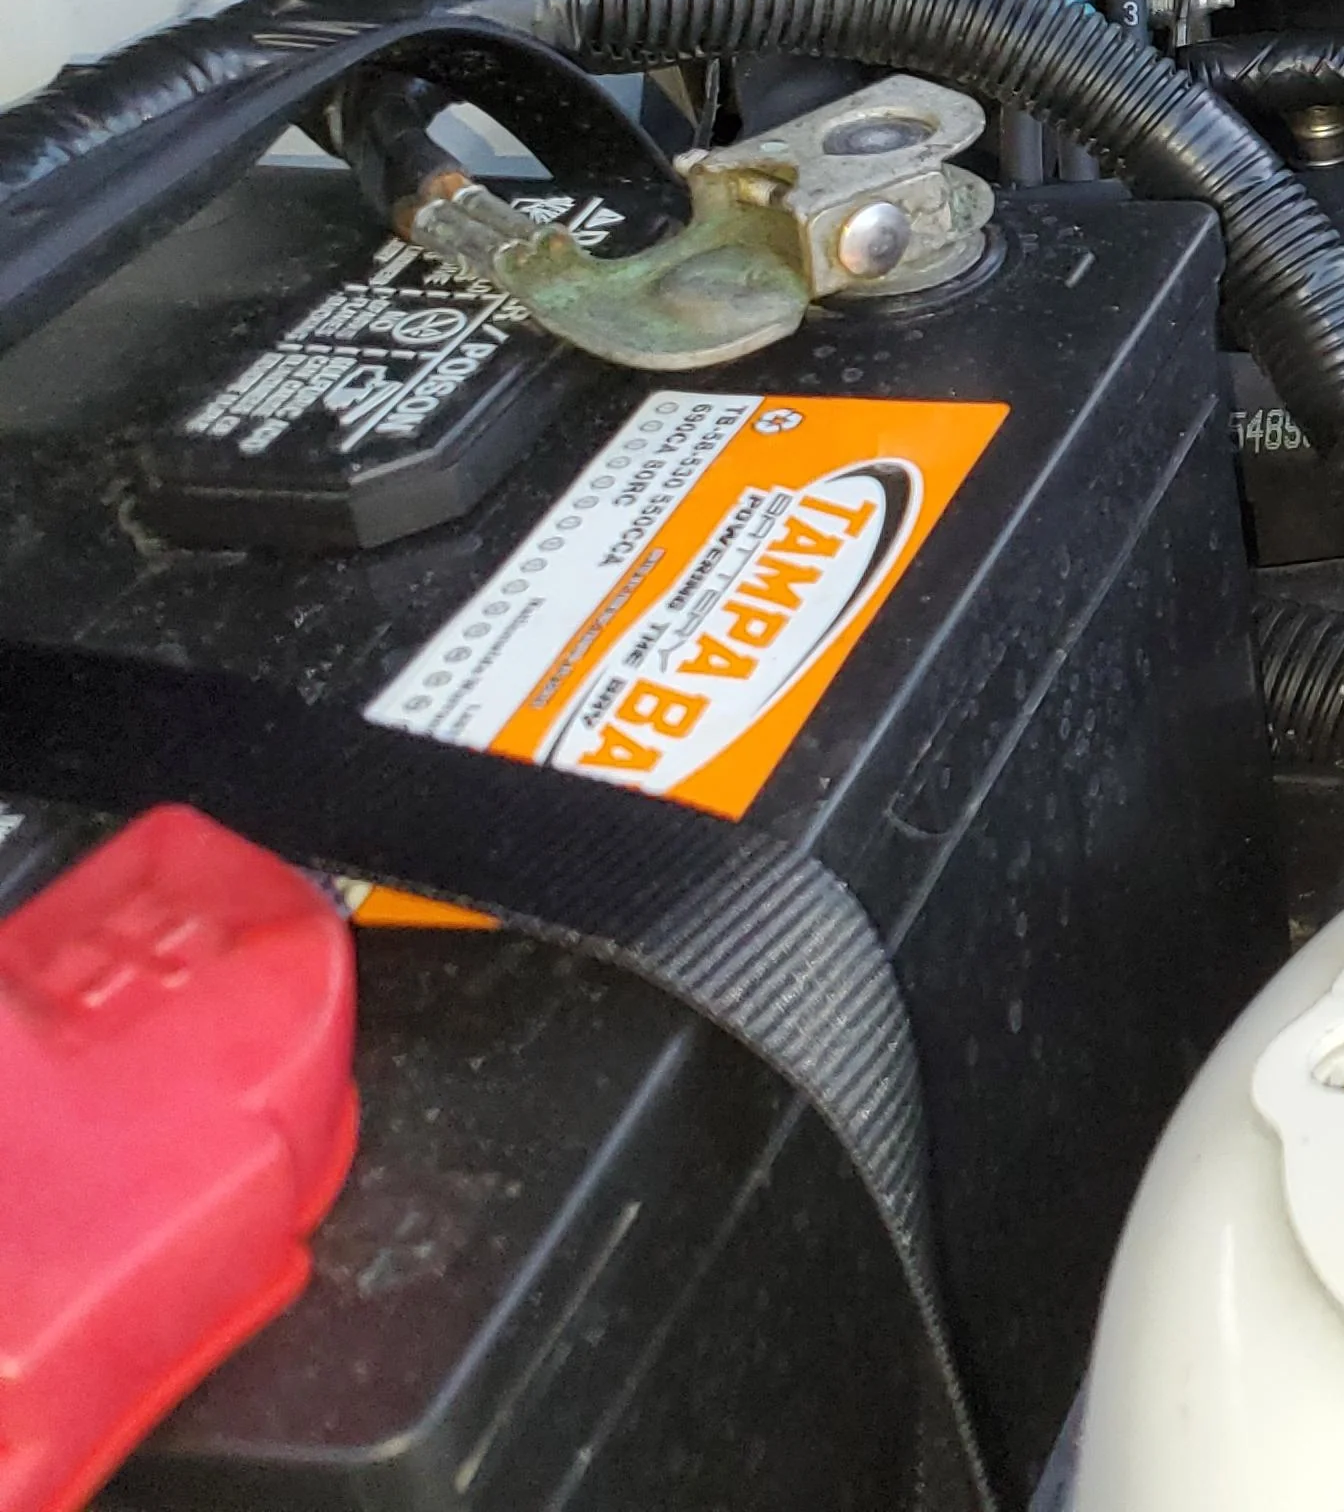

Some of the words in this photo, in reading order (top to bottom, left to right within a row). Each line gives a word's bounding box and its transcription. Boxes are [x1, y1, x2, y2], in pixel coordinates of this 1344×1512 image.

[1123, 1, 1140, 27] 3
[375, 342, 498, 436] POISON
[654, 402, 713, 455] 690CA
[657, 491, 793, 674] BATTERY
[666, 493, 765, 613] POWERING
[675, 494, 877, 676] TAMPA
[621, 620, 672, 670] THE
[577, 676, 711, 774] BA
